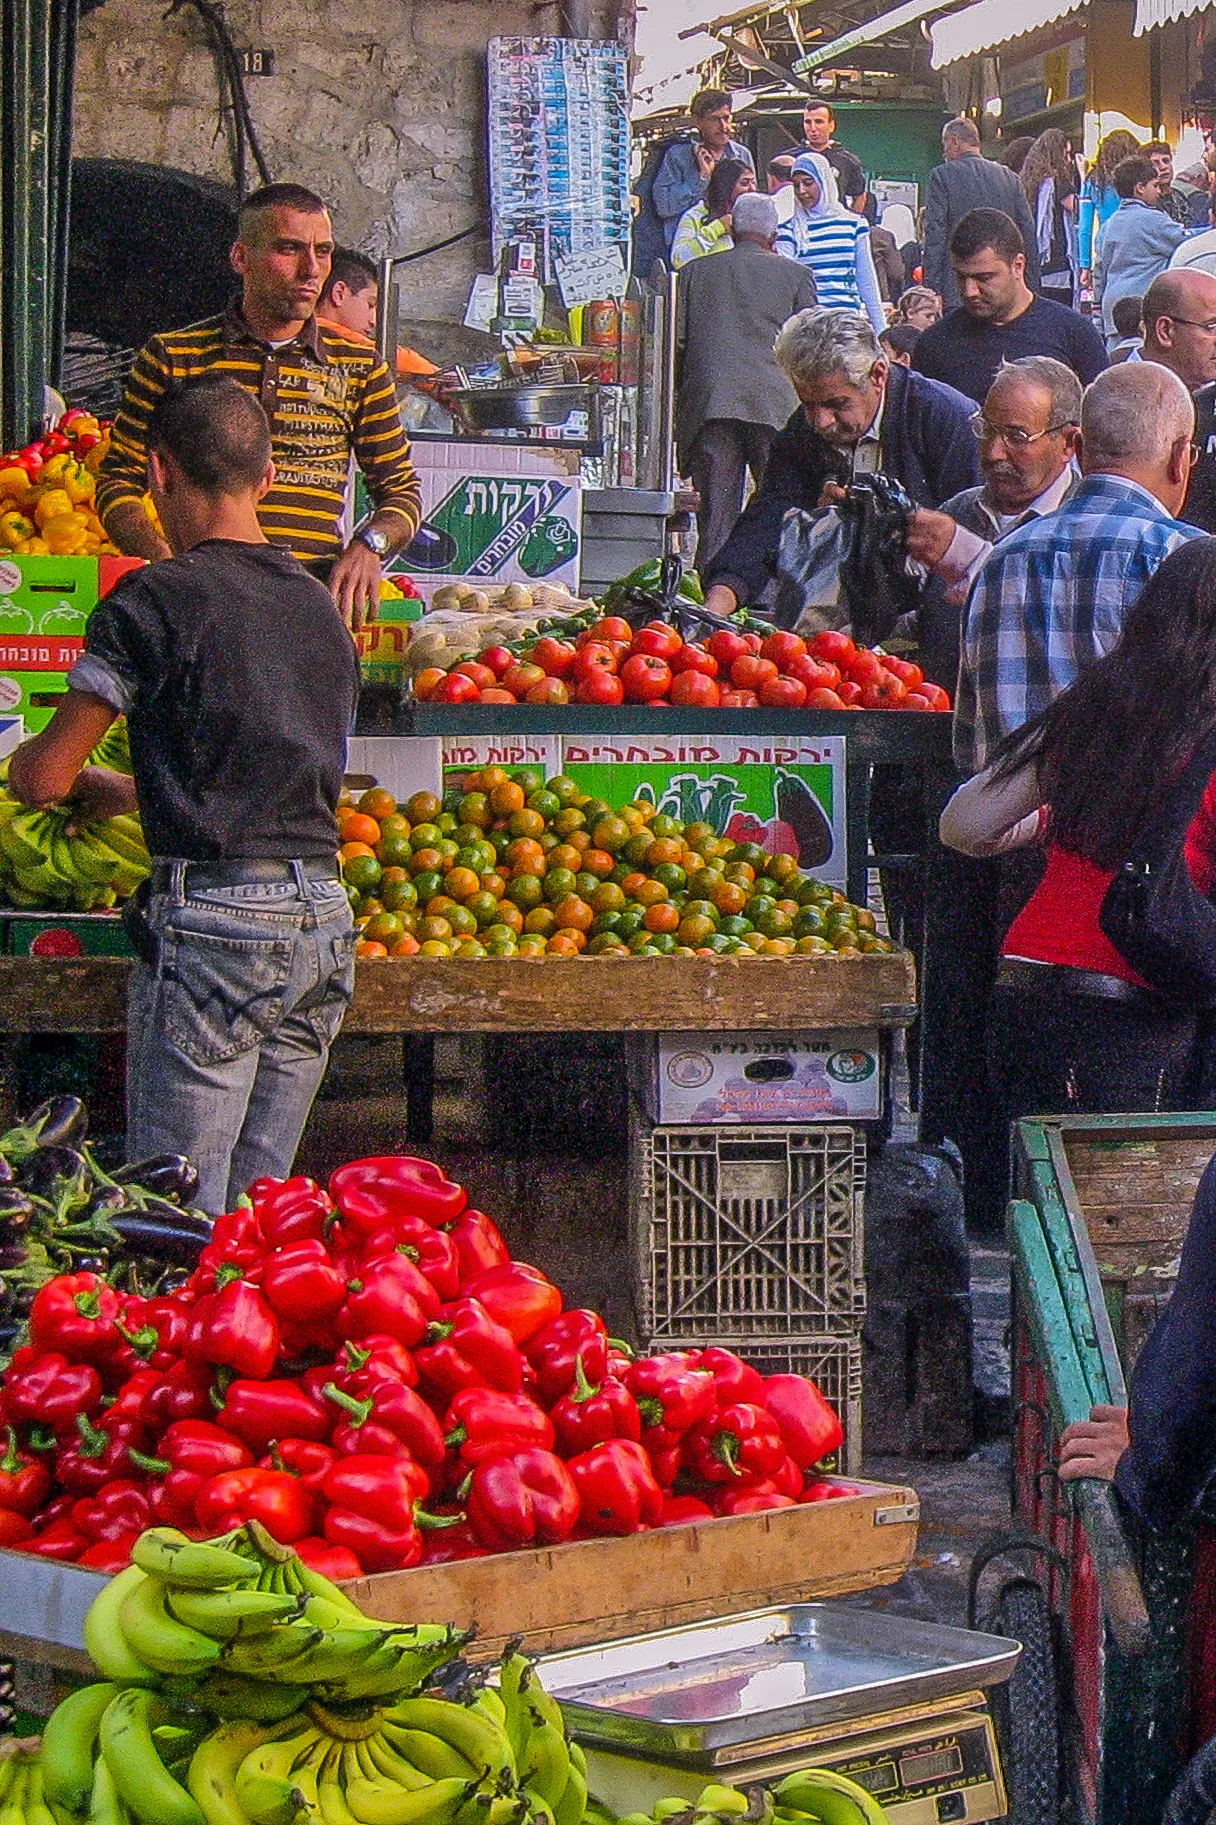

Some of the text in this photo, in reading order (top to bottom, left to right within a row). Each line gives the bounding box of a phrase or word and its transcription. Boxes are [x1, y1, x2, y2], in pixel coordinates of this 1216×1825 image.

[243, 52, 262, 72] 18
[464, 480, 553, 527] ירקות
[476, 520, 527, 574] מובחרים
[486, 746, 547, 765] ירקות
[565, 746, 832, 766] ירקות מובחרים
